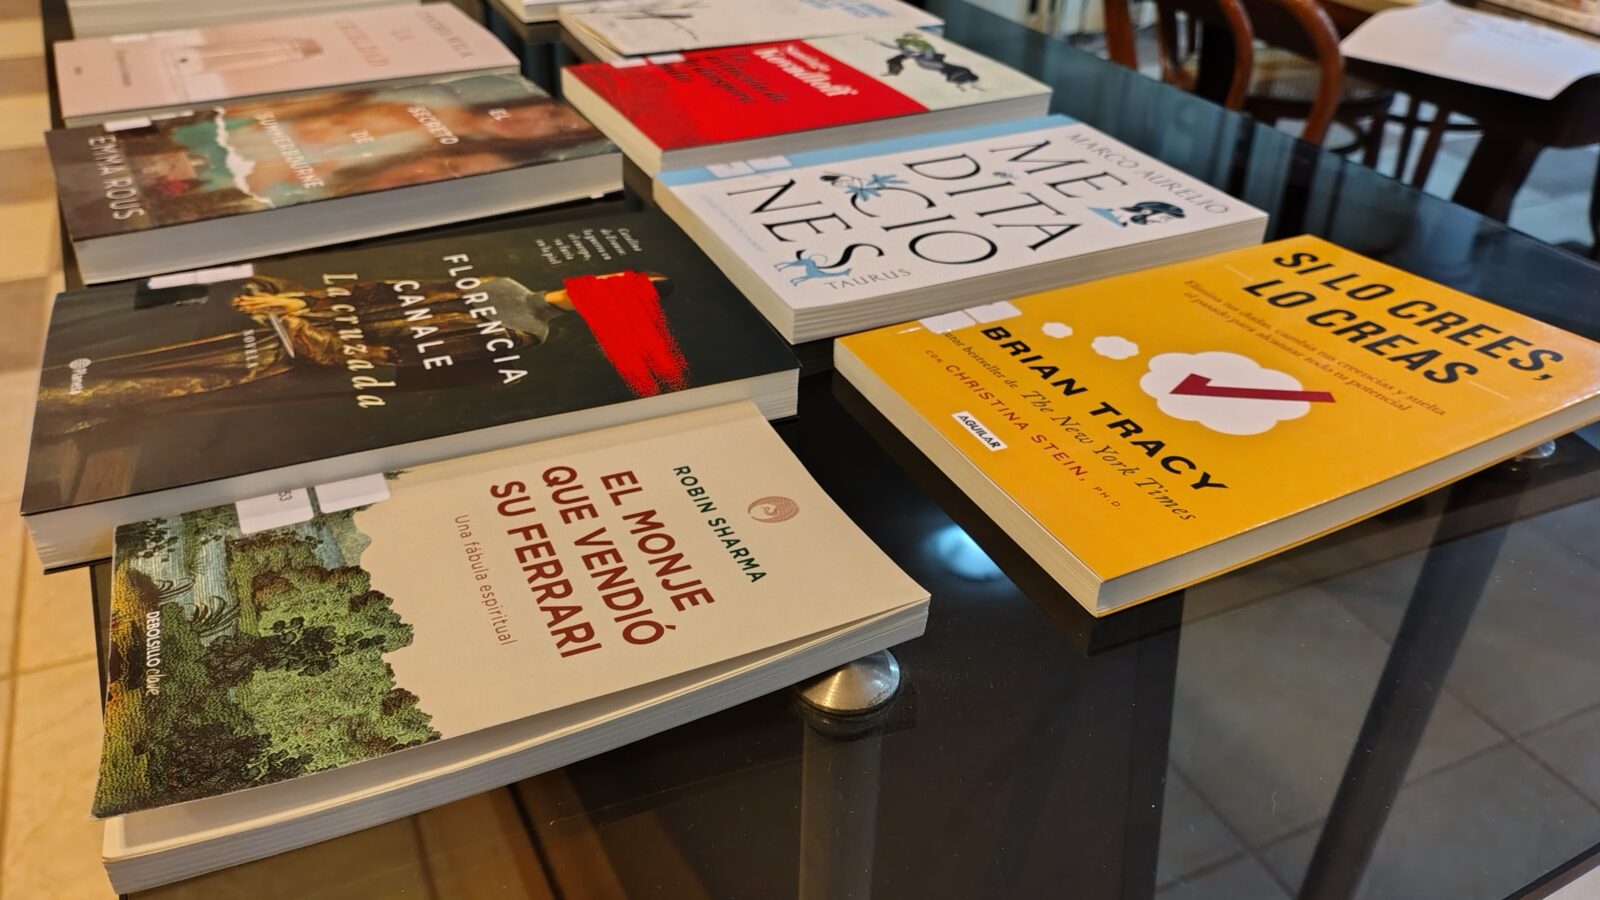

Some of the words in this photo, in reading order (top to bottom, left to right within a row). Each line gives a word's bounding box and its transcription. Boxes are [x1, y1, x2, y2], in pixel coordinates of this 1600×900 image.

[255, 112, 325, 189] SUMMERBOURNE
[351, 129, 375, 144] DE
[407, 105, 459, 145] SECRETO
[488, 107, 511, 121] EL
[88, 134, 125, 177] EMMA
[989, 140, 1128, 198] ME
[1066, 132, 1139, 170] MARCO
[1138, 167, 1229, 215] AURELIO
[103, 177, 145, 220] ROUS
[726, 179, 885, 270] NES
[850, 186, 998, 265] CIO
[903, 153, 1083, 251] DITA
[322, 273, 359, 298] La
[824, 267, 911, 291] TAURUS
[1272, 252, 1334, 275] SI
[1320, 273, 1397, 301] LO
[1386, 300, 1564, 381] CREES,
[243, 329, 259, 369] NOVELA
[331, 303, 397, 409] cruzada
[392, 280, 453, 370] CANALE
[442, 253, 528, 385] FLORENCIA
[1242, 279, 1317, 309] LO
[1305, 309, 1479, 385] CREAS
[980, 326, 1088, 397] BRIAN
[1089, 401, 1229, 492] TRACY
[1337, 361, 1395, 390] creencias
[1407, 395, 1447, 416] suelta
[1344, 378, 1412, 411] potencial
[945, 364, 1030, 431] CHRISTINA
[1031, 434, 1088, 482] STEIN,
[1093, 486, 1123, 509] PH.D.
[956, 414, 1001, 449] AGUILAR
[963, 345, 1006, 379] bestseller
[1004, 378, 1019, 390] de
[1022, 390, 1055, 413] The
[1051, 416, 1094, 445] New
[1091, 445, 1140, 477] York
[1134, 477, 1197, 521] Times
[490, 480, 537, 517] SU
[673, 465, 718, 514] ROBIN
[707, 516, 768, 583] SHARMA
[454, 514, 472, 539] Una
[464, 541, 490, 581] fábula
[479, 584, 518, 646] espiritual
[542, 466, 600, 525] QUE
[573, 526, 677, 645] VENDIÓ
[600, 470, 643, 506] EL
[622, 509, 716, 613] MONJE
[506, 523, 603, 658] FERRARI
[146, 610, 161, 668] DEBOLSILLO
[145, 668, 168, 697] clave
